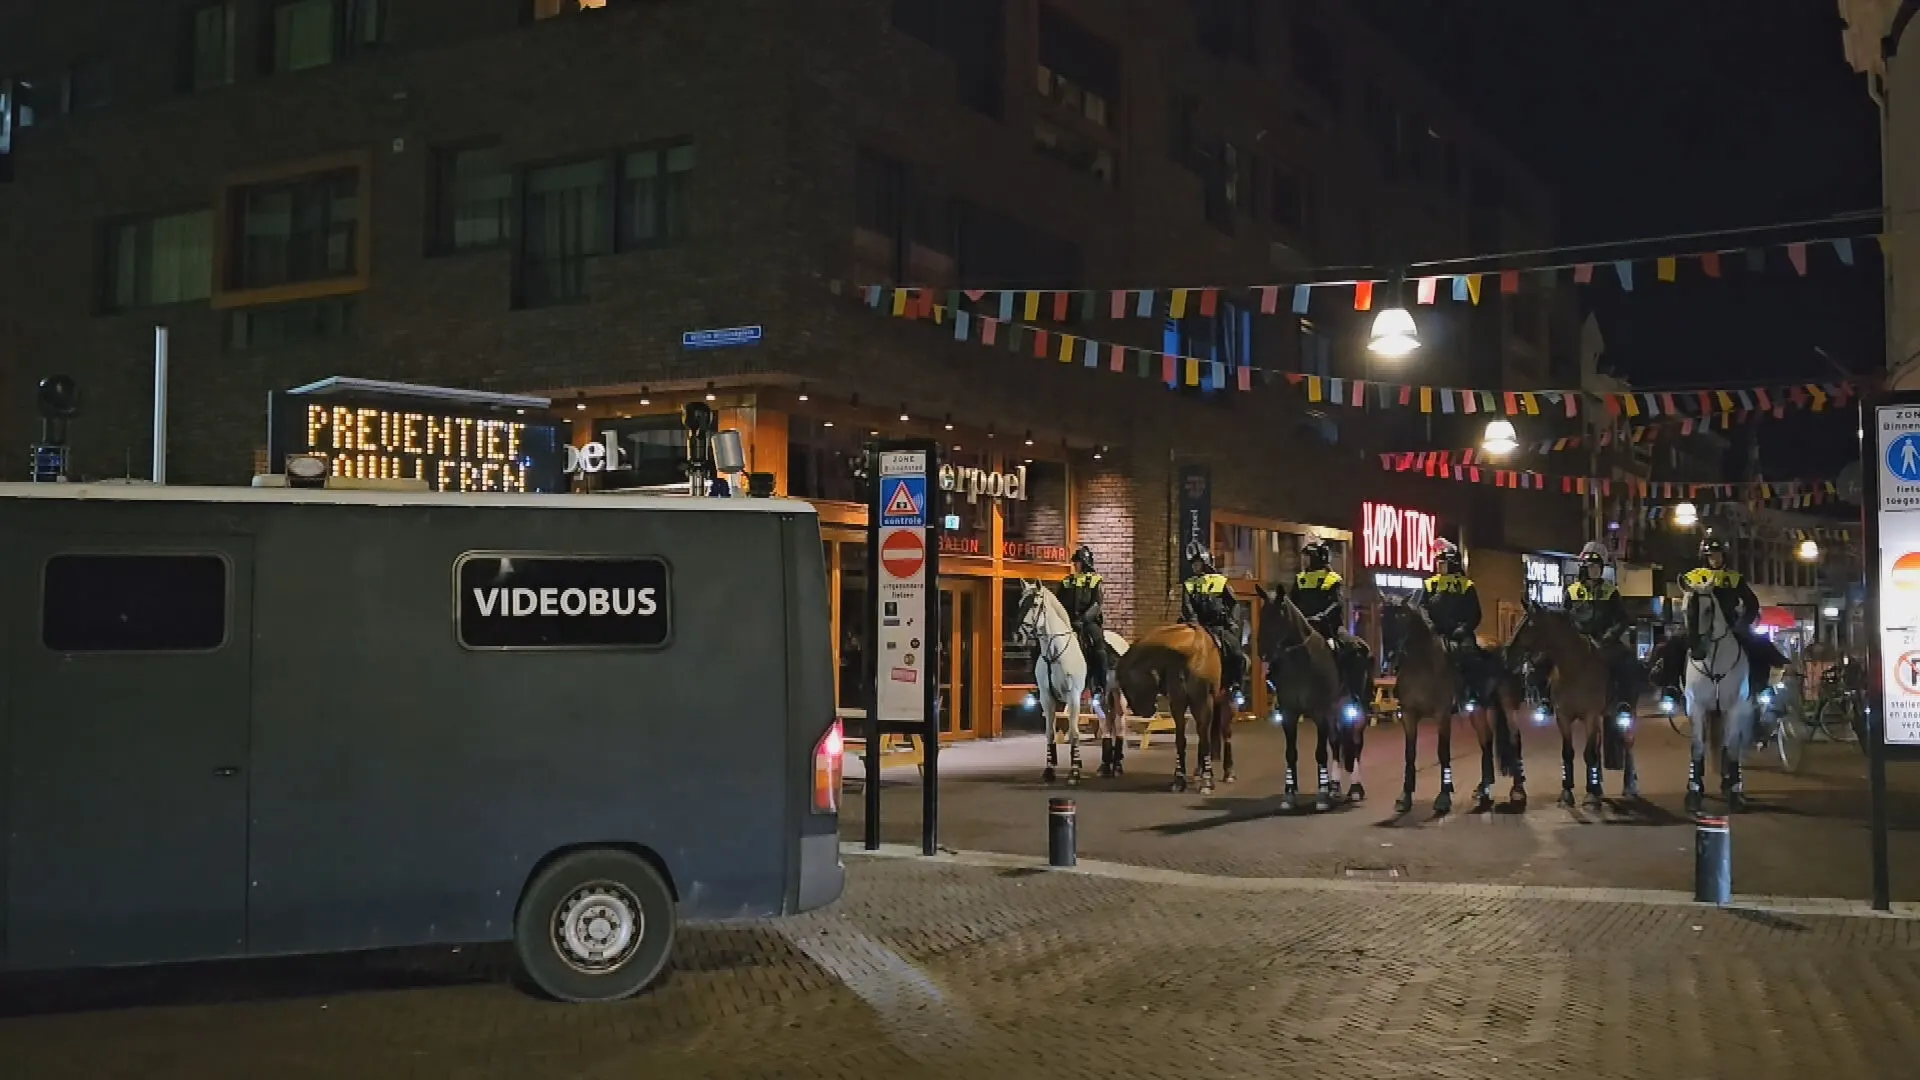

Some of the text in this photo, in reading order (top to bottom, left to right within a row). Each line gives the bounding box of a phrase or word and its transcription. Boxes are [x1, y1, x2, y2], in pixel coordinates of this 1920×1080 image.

[308, 404, 525, 460] PREVENTIEF
[1363, 501, 1403, 569] HAPPY
[473, 587, 657, 617] VIDEOBUS
